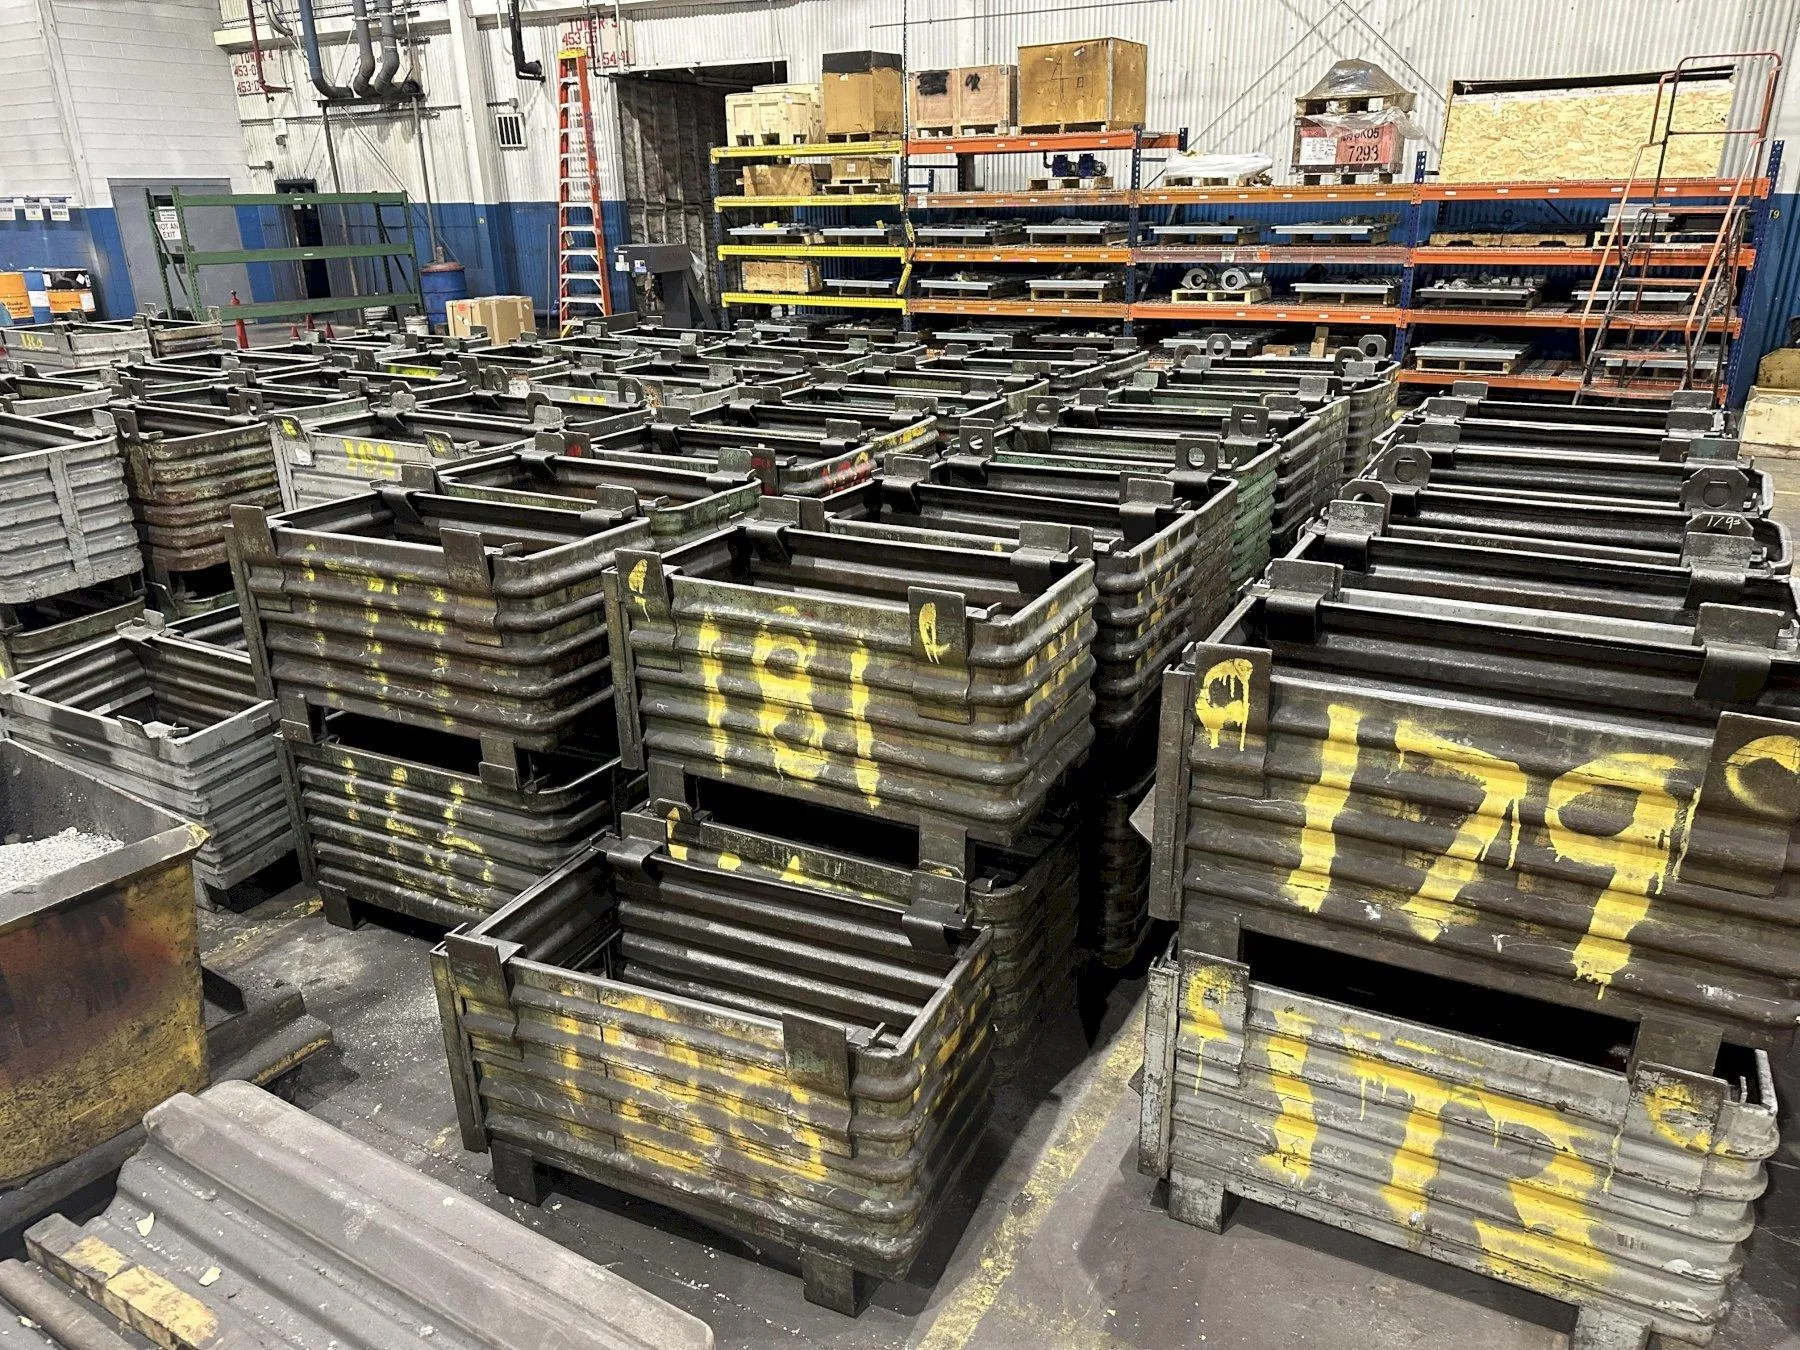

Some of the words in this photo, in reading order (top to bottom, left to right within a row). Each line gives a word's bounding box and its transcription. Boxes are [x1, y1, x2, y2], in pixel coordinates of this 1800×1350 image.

[1348, 144, 1379, 162] 7293
[163, 231, 176, 239] EXIT
[1284, 704, 1688, 999] 179
[1260, 1004, 1616, 1284] 173
